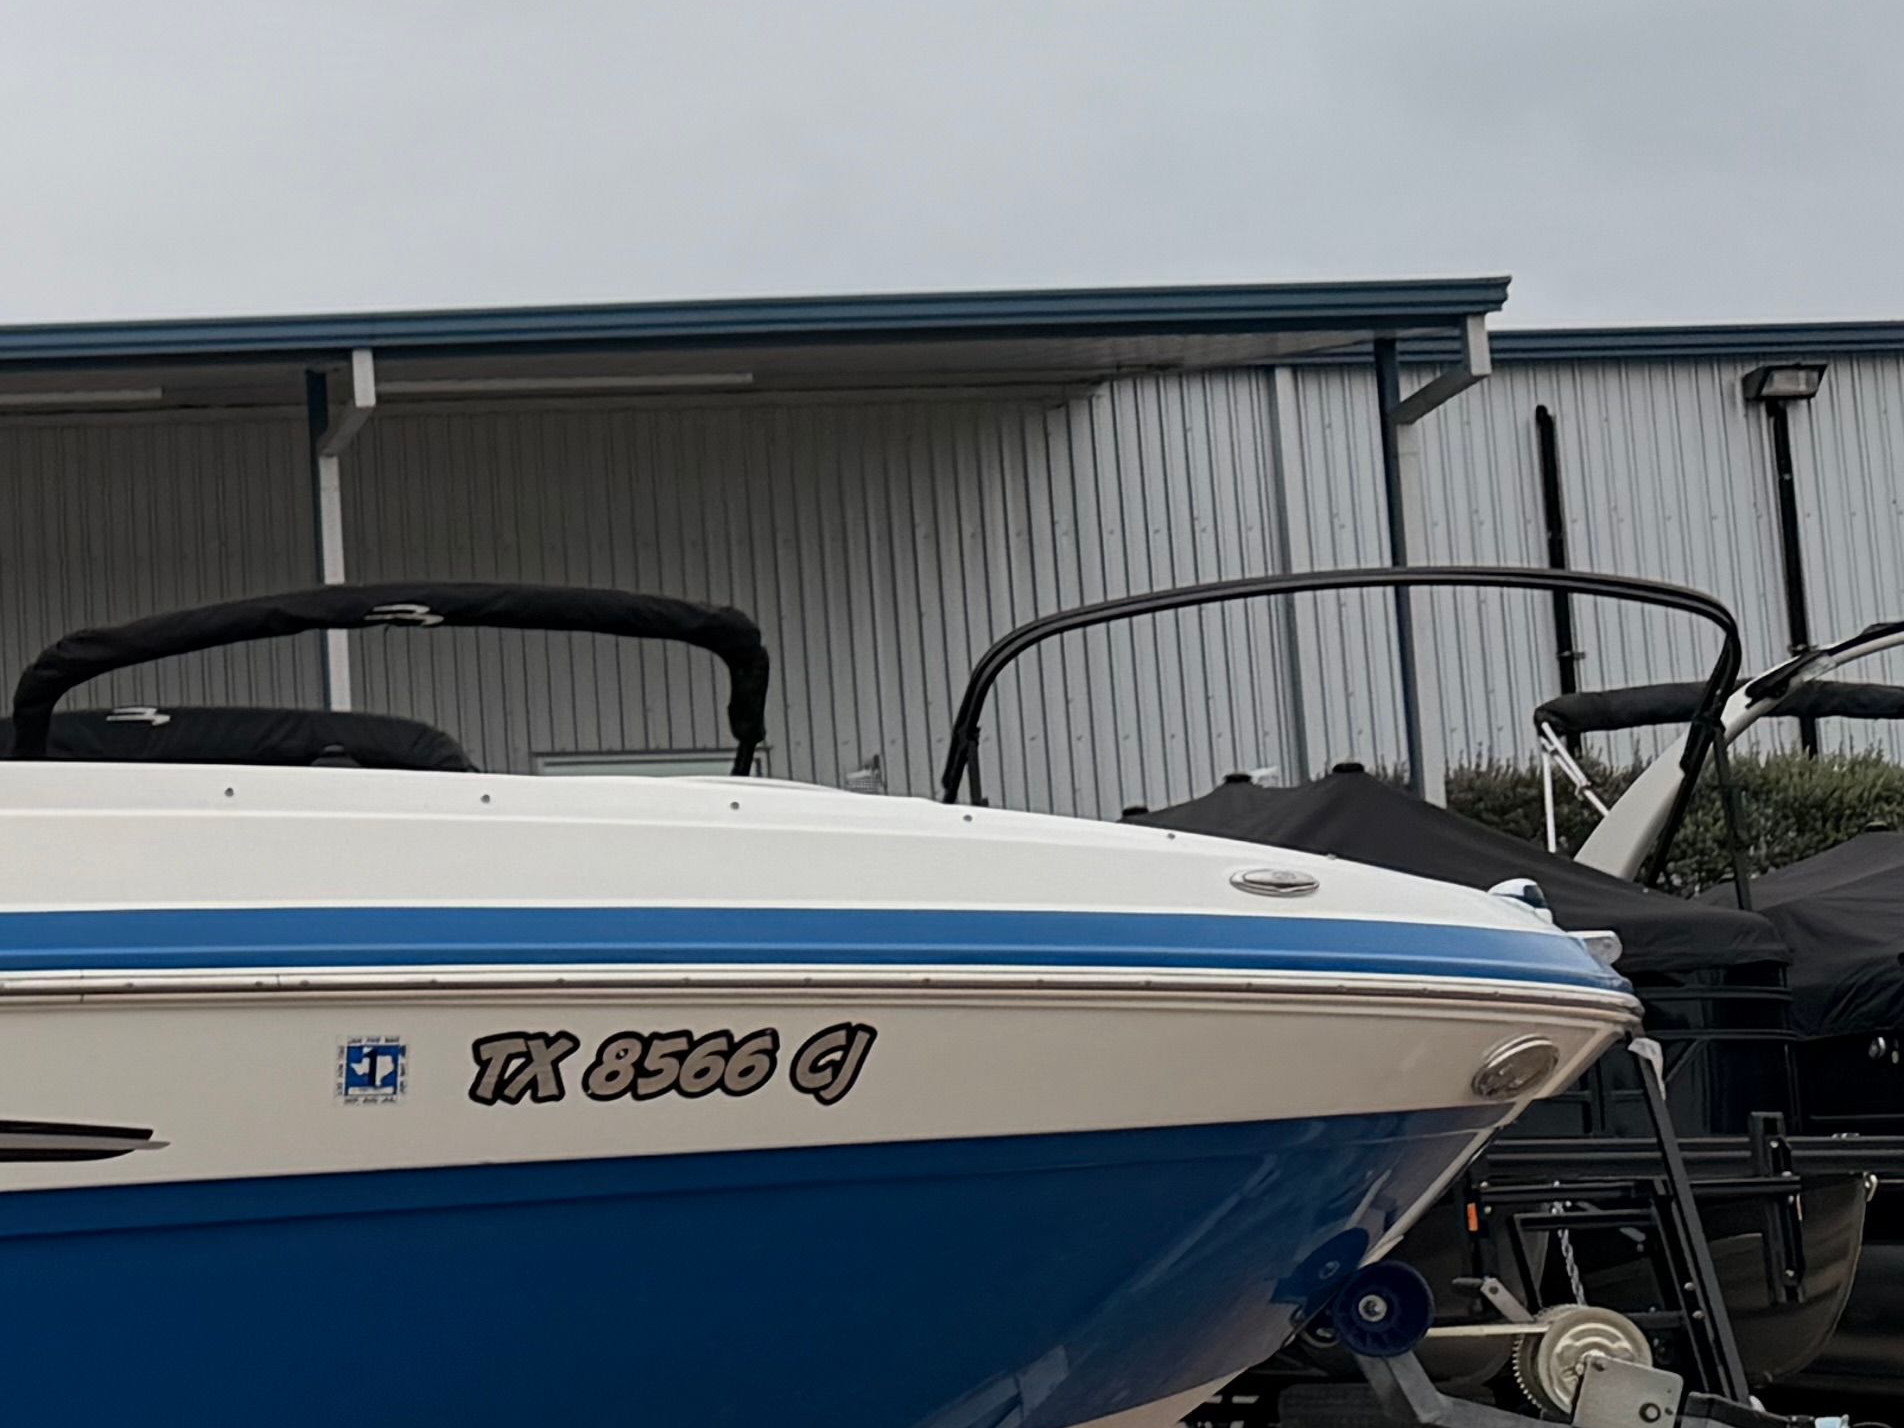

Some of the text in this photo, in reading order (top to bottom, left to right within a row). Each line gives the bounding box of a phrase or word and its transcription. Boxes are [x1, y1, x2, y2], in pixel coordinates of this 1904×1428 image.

[469, 1030, 580, 1105] TX
[582, 1027, 780, 1101] 8566
[790, 1022, 877, 1106] CJ
